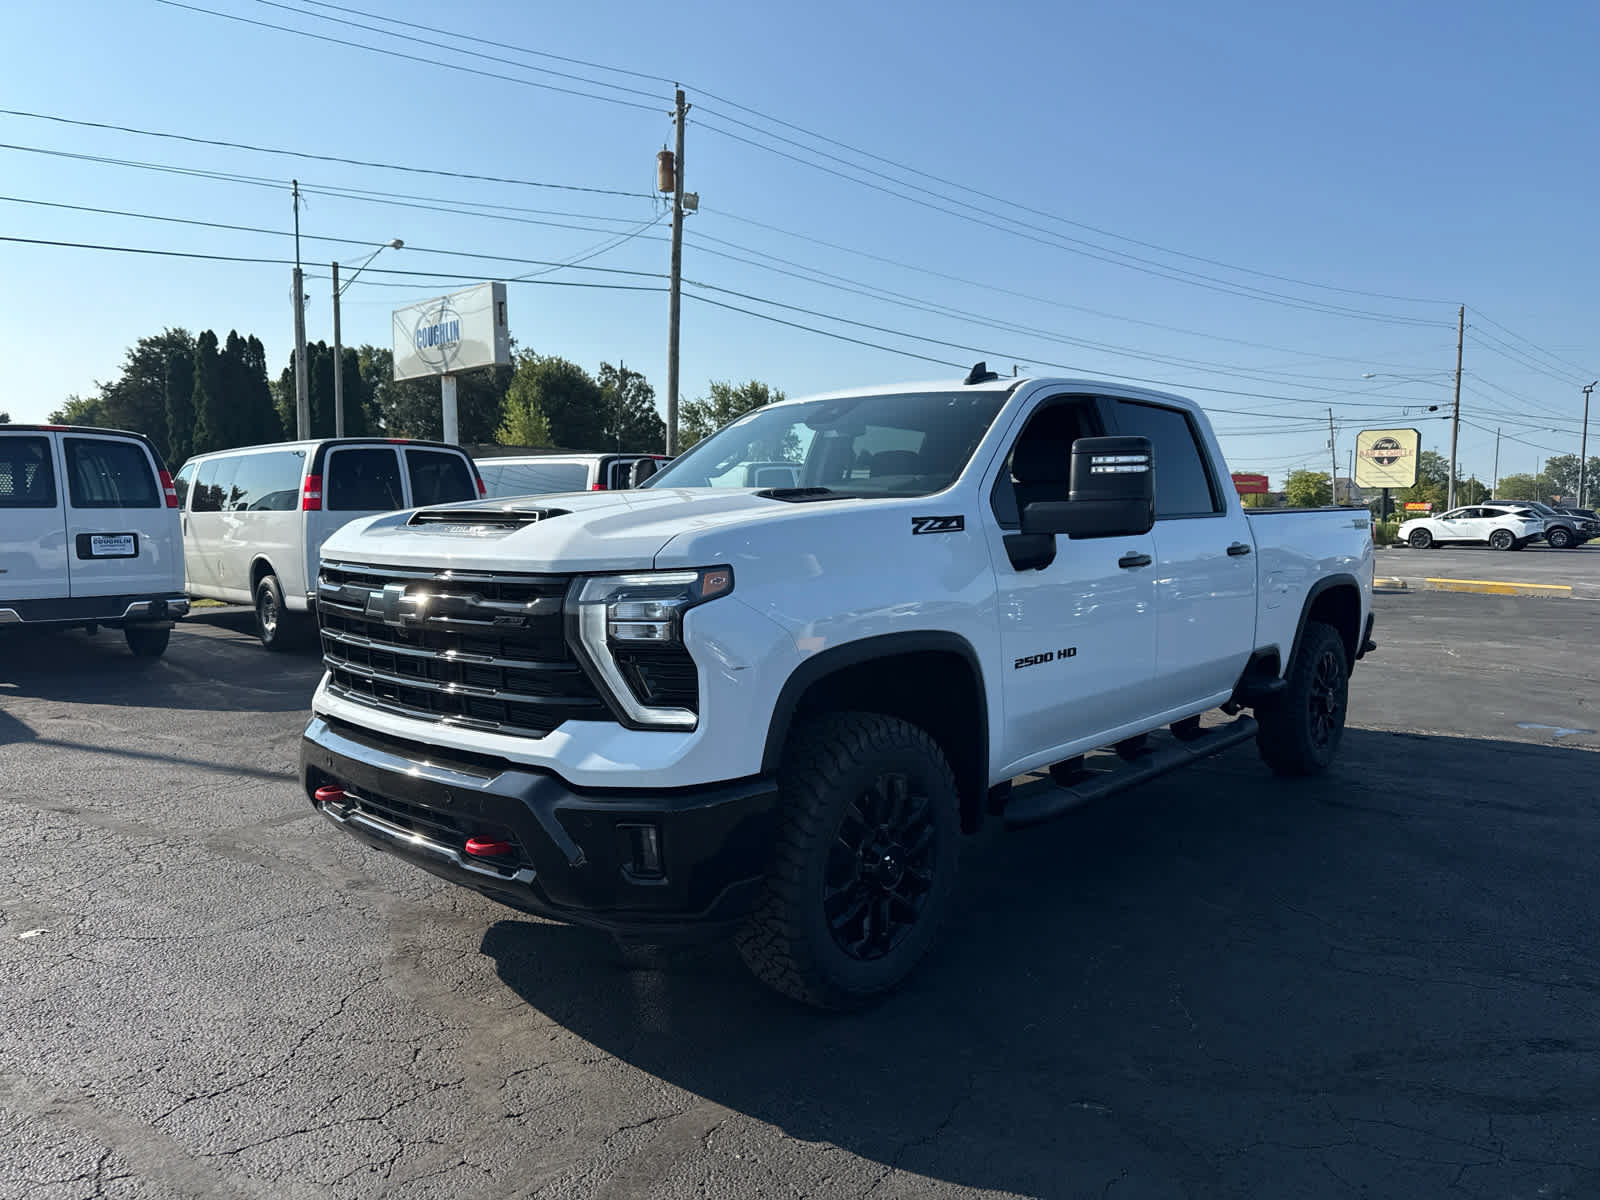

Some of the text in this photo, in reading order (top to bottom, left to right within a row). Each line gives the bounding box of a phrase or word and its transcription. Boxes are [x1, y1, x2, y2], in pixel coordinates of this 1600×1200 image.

[416, 320, 459, 349] COUGHLIN
[93, 537, 131, 545] COUGHLIN
[1014, 647, 1077, 670] 2500 HD
